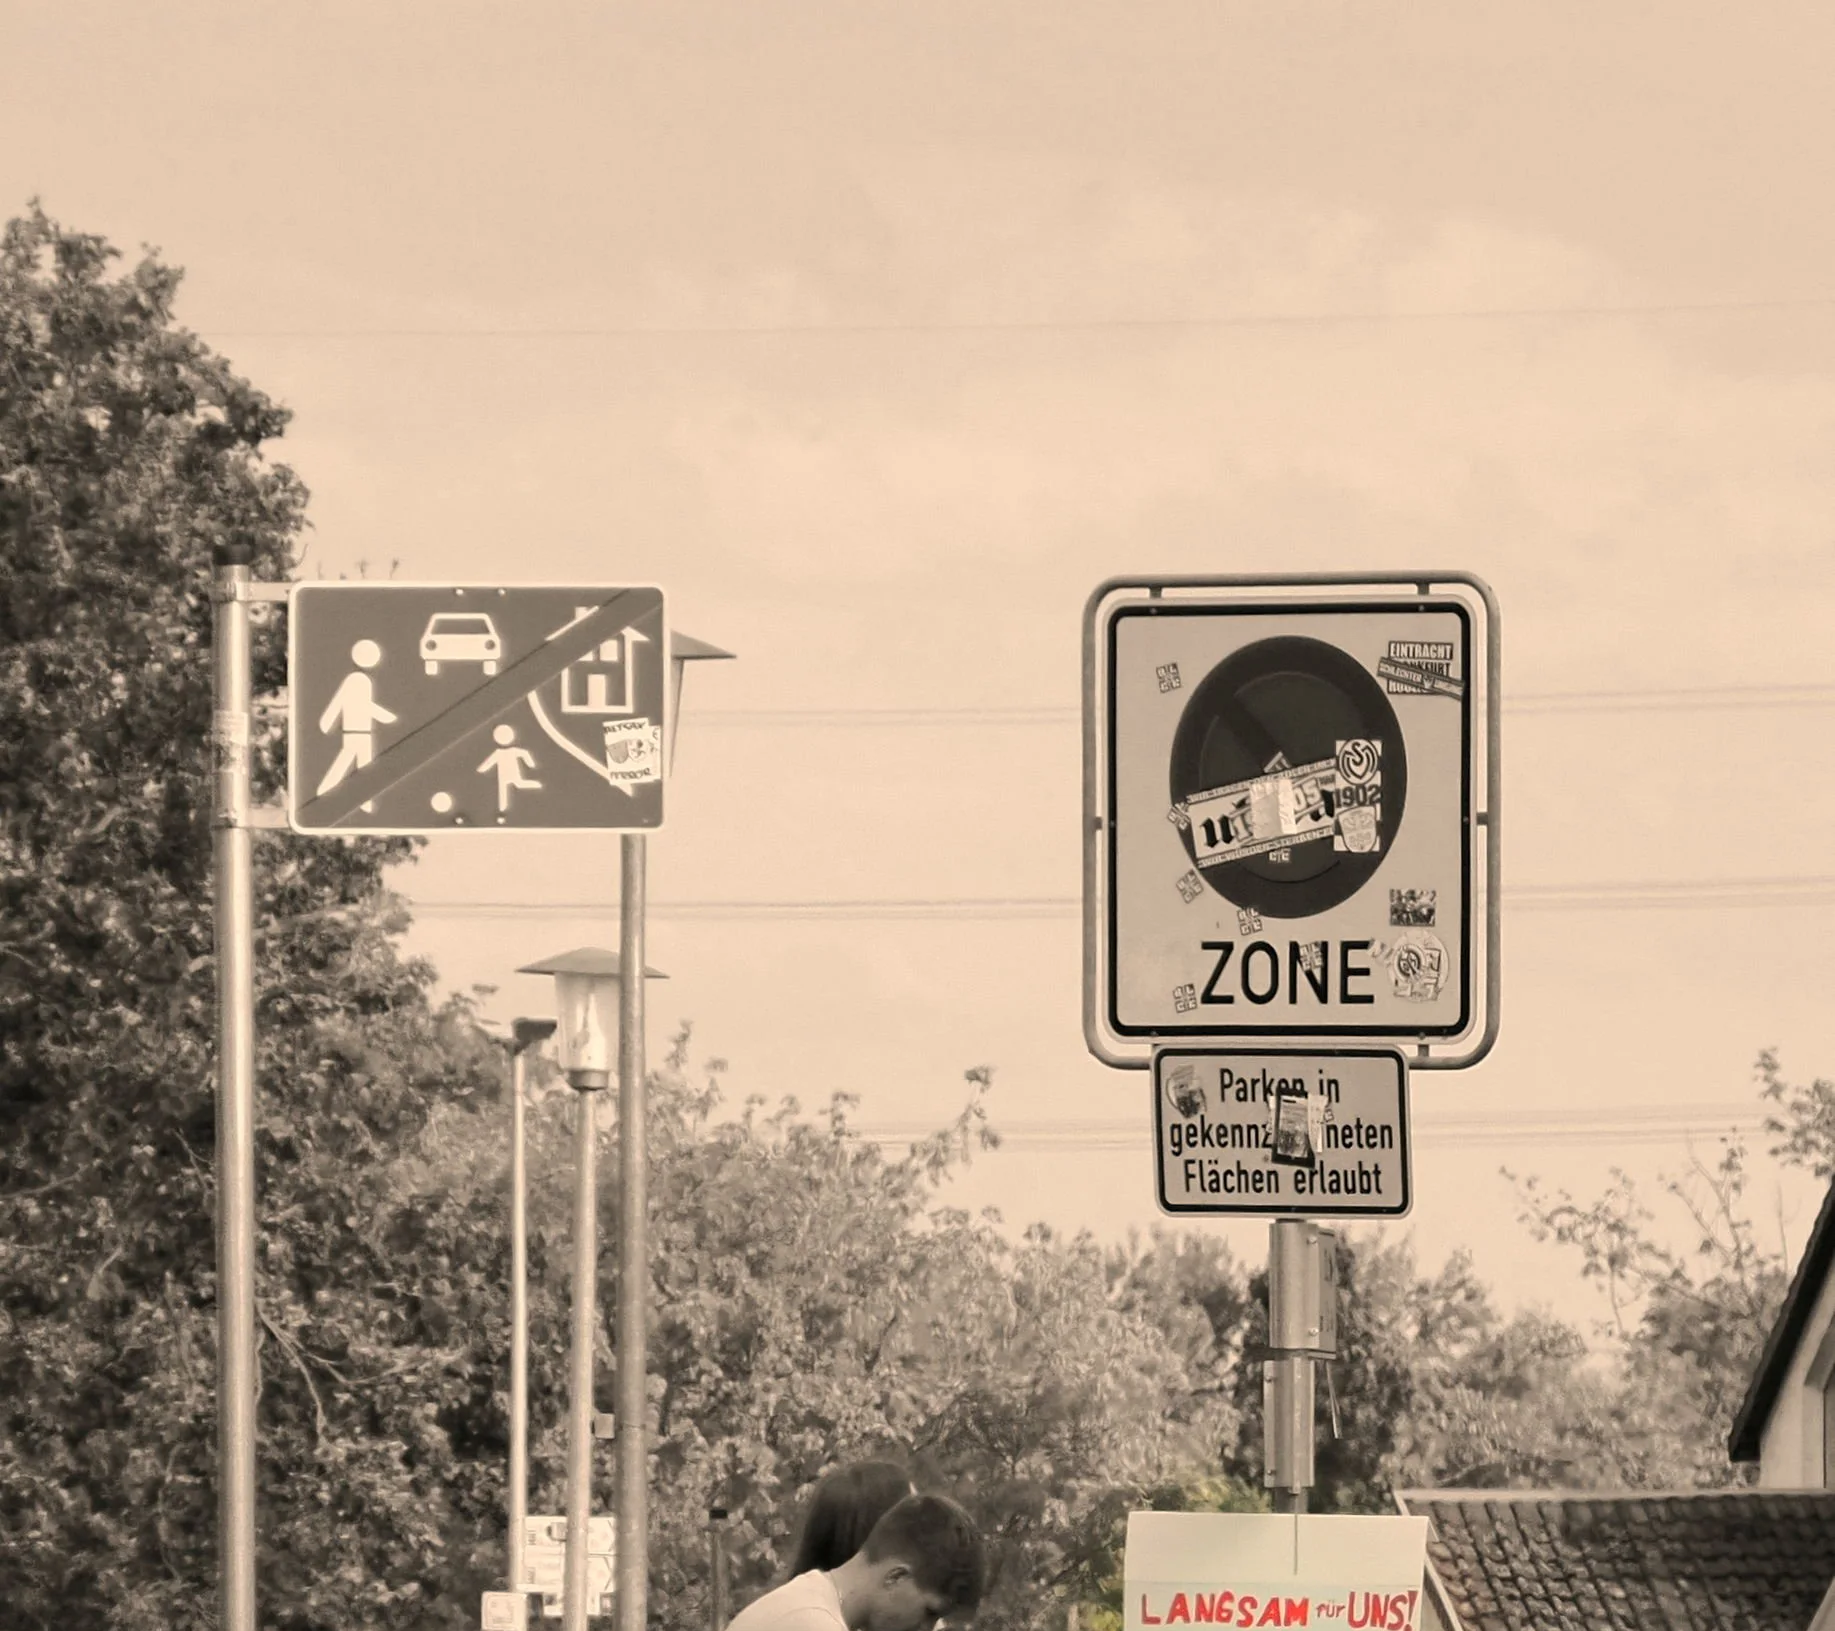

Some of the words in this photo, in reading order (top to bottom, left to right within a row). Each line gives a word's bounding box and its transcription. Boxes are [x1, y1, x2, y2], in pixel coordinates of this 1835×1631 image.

[1389, 642, 1452, 659] EINTRACHT
[1336, 784, 1381, 808] 1902
[1200, 940, 1374, 1005] ZONE
[1318, 1069, 1340, 1103] in
[1170, 1114, 1393, 1156] gekennzneten
[1184, 1159, 1279, 1194] Flächen
[1294, 1160, 1382, 1195] erlaubt
[1140, 1591, 1309, 1628] LANGSAM
[1316, 1601, 1345, 1619] für
